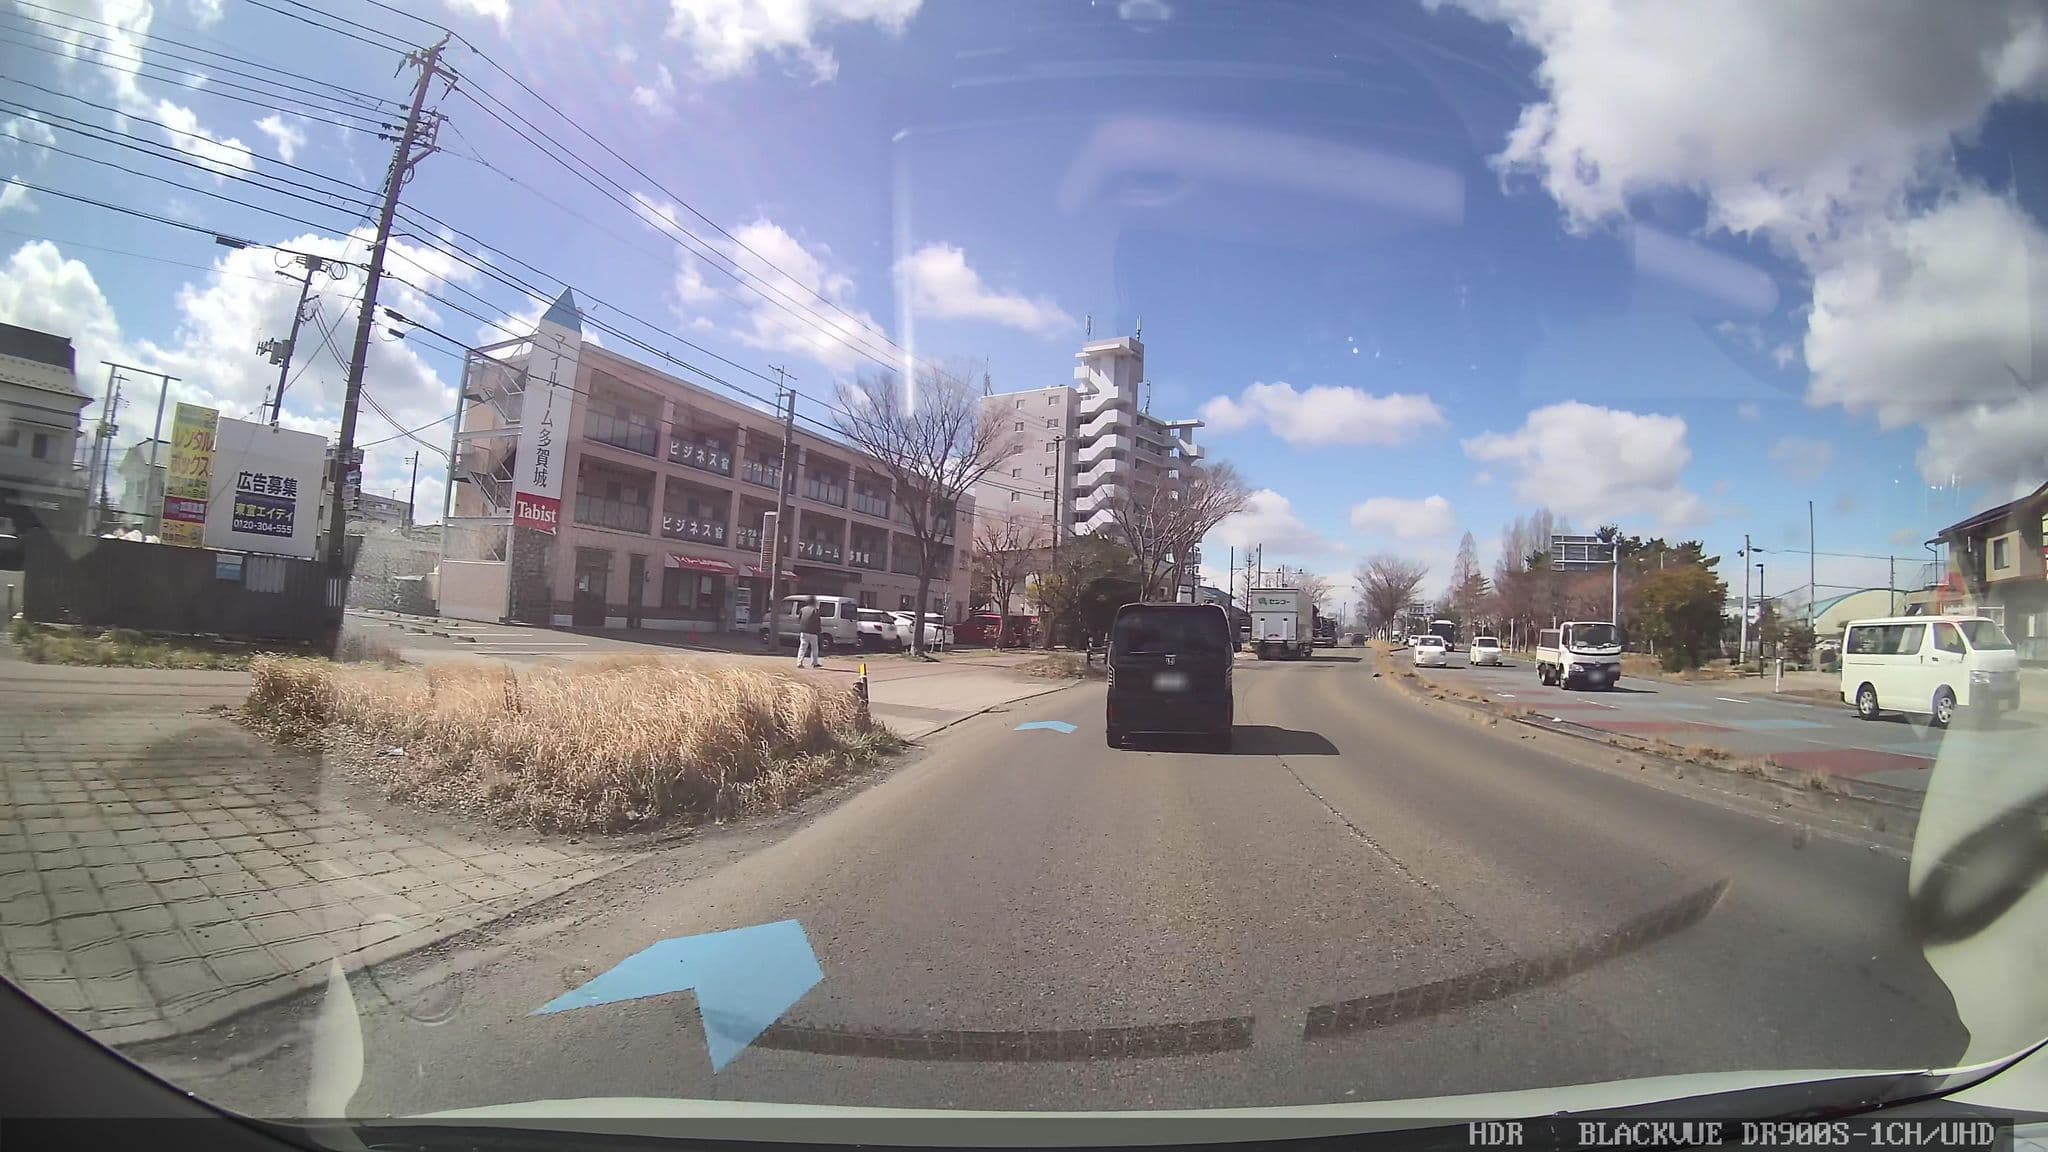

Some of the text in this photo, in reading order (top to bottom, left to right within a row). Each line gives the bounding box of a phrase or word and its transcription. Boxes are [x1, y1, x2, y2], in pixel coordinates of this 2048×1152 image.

[533, 333, 566, 488] マイルーム多賀城
[174, 427, 214, 453] レンタル
[237, 471, 298, 497] 広告募集
[516, 500, 557, 523] Tabist
[233, 519, 292, 534] 0120-304-555
